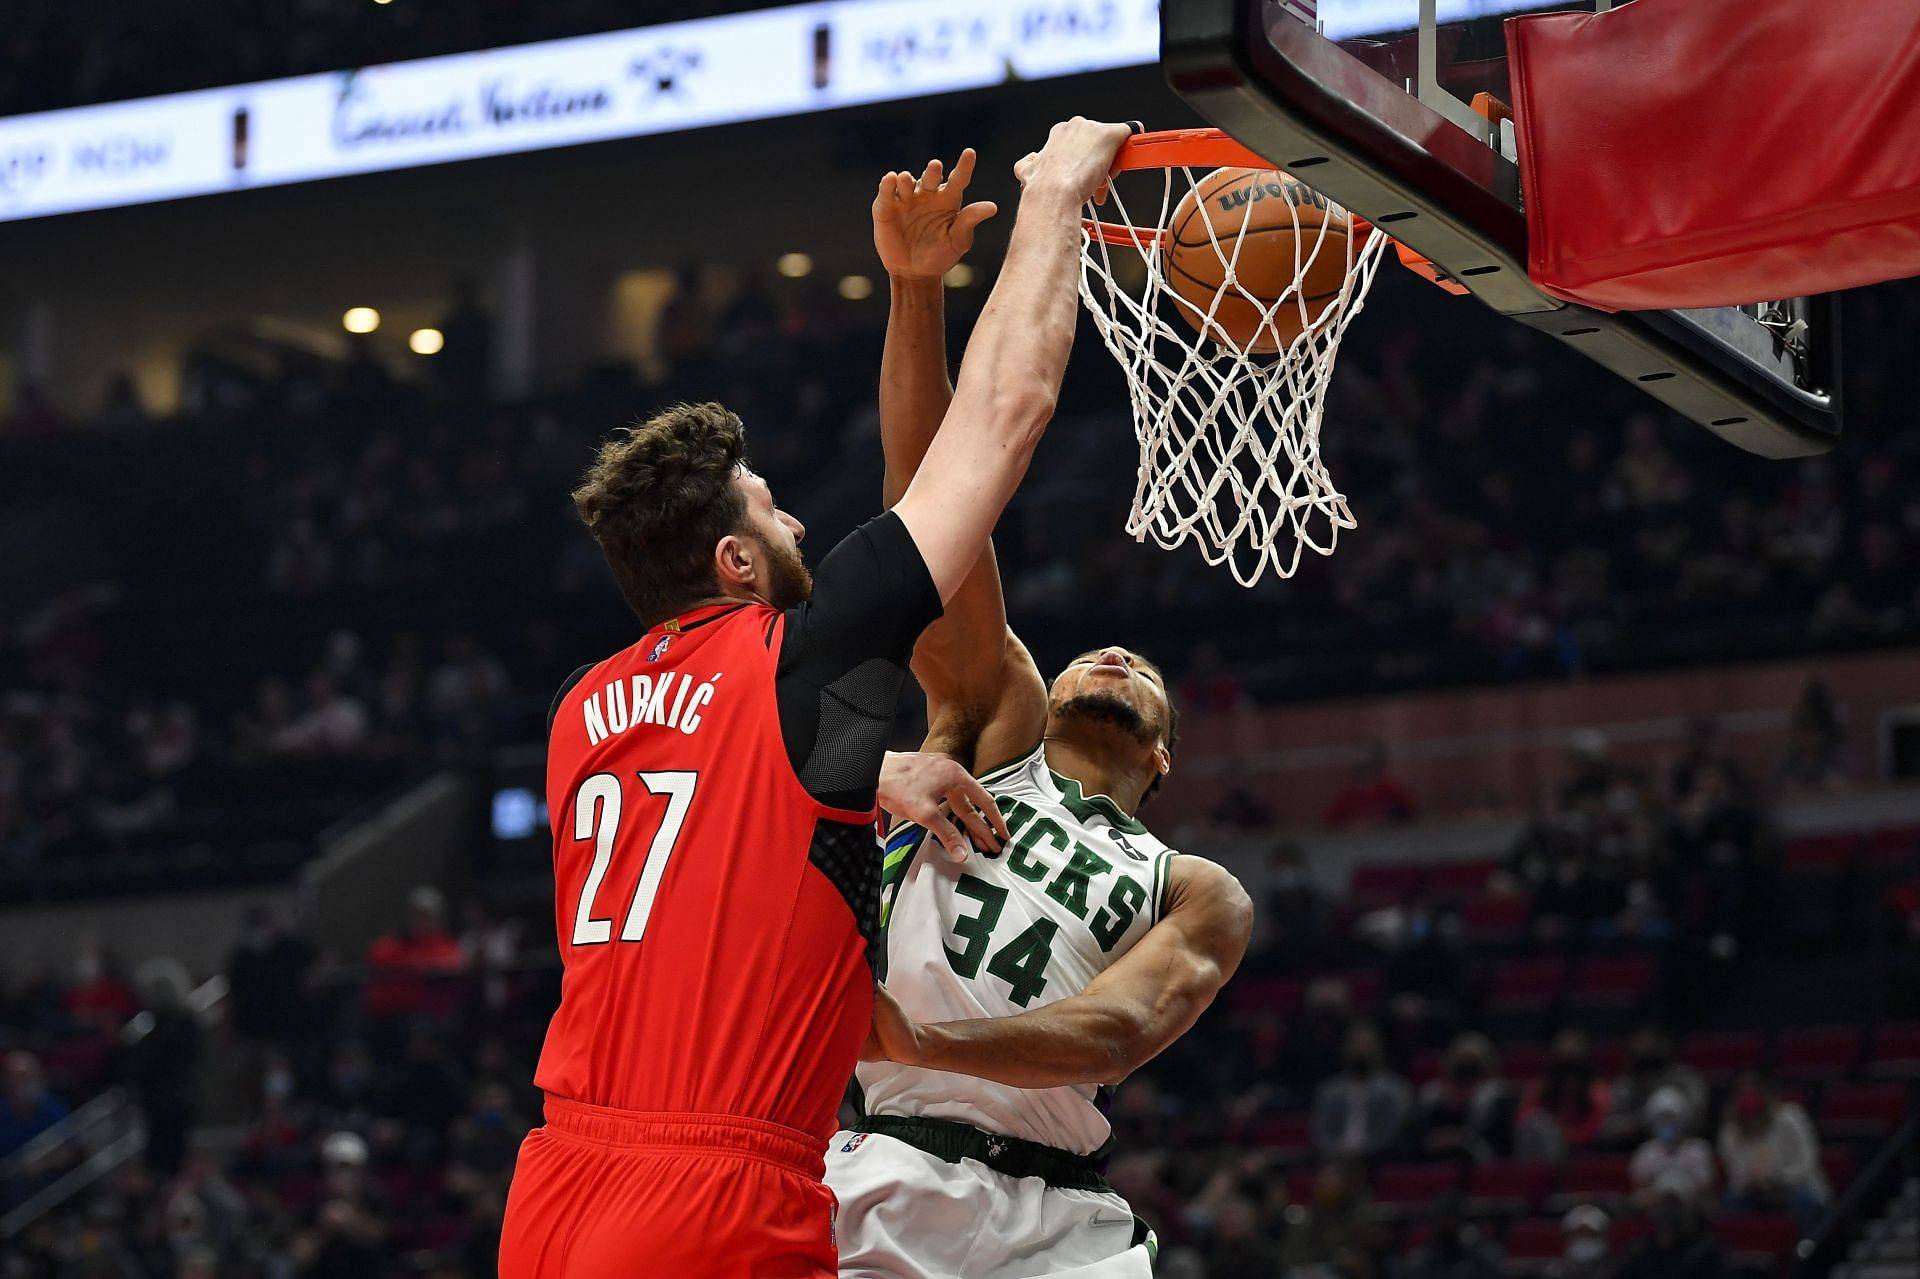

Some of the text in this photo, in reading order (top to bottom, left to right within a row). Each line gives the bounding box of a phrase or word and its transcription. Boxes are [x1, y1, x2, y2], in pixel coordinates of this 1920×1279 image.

[583, 671, 723, 746] NURKIĆ
[572, 770, 699, 946] 27
[970, 795, 1147, 953] UCKS
[942, 873, 1059, 1009] 34
